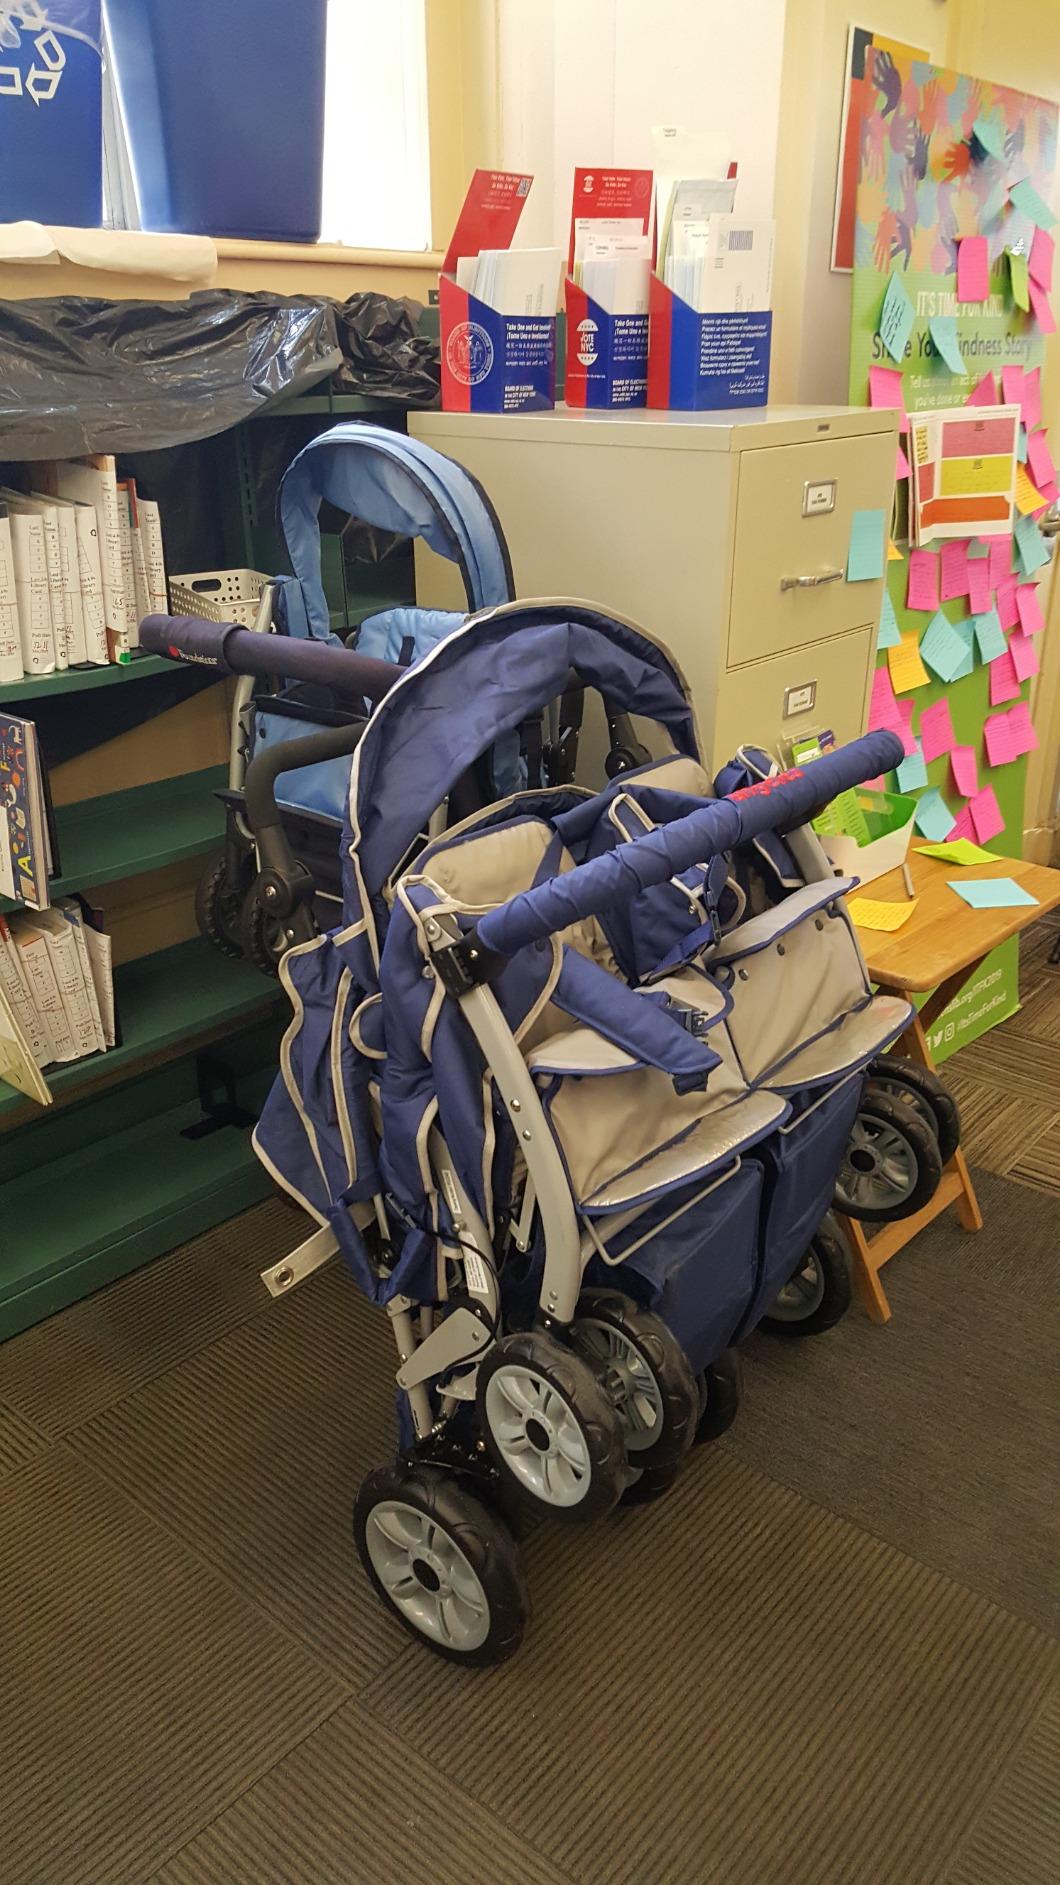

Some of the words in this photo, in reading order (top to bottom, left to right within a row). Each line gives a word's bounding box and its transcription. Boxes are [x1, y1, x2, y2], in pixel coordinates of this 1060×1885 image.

[916, 291, 936, 317] IT'S
[580, 342, 594, 352] NYC
[872, 331, 911, 358] She
[957, 332, 1001, 358] indness
